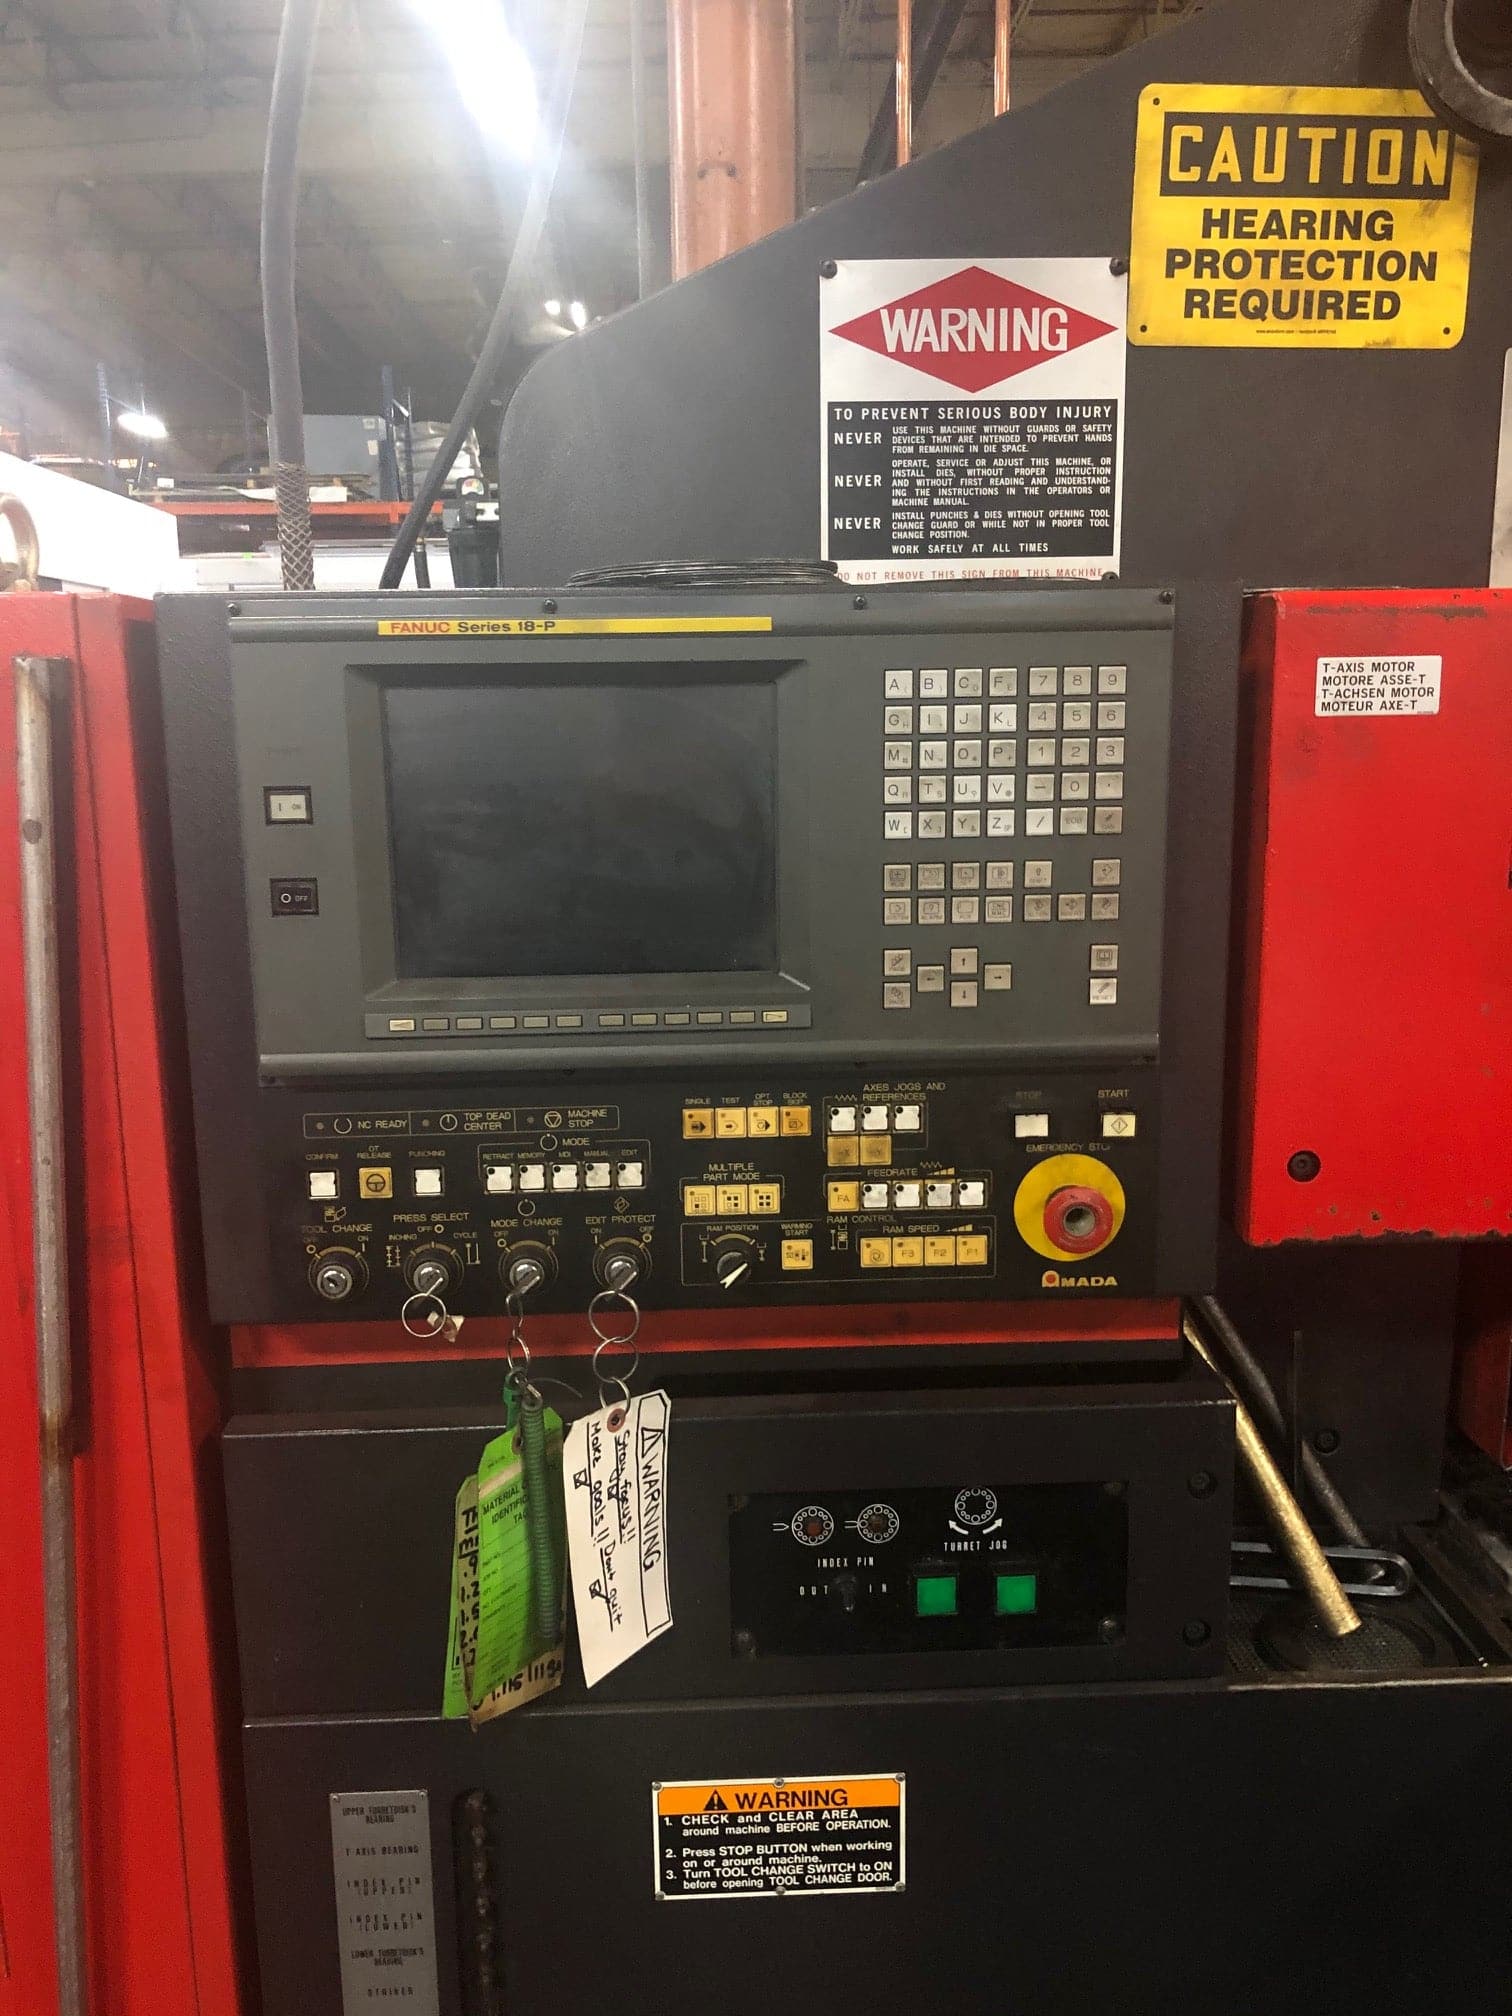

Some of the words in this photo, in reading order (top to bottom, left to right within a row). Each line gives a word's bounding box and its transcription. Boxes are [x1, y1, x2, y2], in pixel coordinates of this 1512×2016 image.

[1169, 125, 1450, 186] CAUTION
[1202, 208, 1394, 241] HEARING
[1165, 248, 1438, 281] PROTECTION
[1184, 288, 1400, 322] REQUIRED
[880, 308, 1068, 352] WARNING
[834, 408, 852, 420] TO
[861, 408, 929, 420] PREVENT
[938, 407, 1001, 419] SERIOUS
[1010, 406, 1047, 418] BODY
[1056, 406, 1111, 418] INJURY
[892, 426, 908, 434] USE
[915, 426, 933, 434] THIS
[940, 426, 976, 434] MACHINE
[983, 425, 1020, 433] WITHOUT
[1027, 425, 1059, 433] GUARDS
[1065, 425, 1076, 433] OR
[1082, 424, 1112, 432] SAFETY
[834, 433, 882, 444] NEVER
[892, 436, 925, 444] DEVICES
[931, 436, 952, 444] THAT
[980, 435, 1020, 443] INTENDED
[1026, 435, 1037, 443] TO
[1042, 434, 1079, 442] PREVENT
[1085, 434, 1112, 442] HANDS
[892, 446, 914, 454] FROM
[919, 445, 964, 453] REMAINING
[970, 445, 978, 453] IN
[984, 445, 997, 453] DIE
[1002, 444, 1029, 452] SPACE.
[892, 460, 930, 468] OPERATE,
[936, 459, 969, 467] SERVICE
[976, 459, 986, 467] OR
[993, 458, 1024, 466] ADJUST
[1031, 458, 1049, 466] THIS
[1056, 458, 1094, 466] MACHINE,
[1101, 457, 1111, 465] OR
[892, 469, 925, 477] INSTALL
[936, 469, 956, 477] DIES,
[967, 468, 1003, 476] WITHOUT
[1015, 468, 1045, 476] PROPER
[1056, 467, 1111, 475] INSTRUCTION
[834, 475, 882, 487] NEVER
[892, 479, 909, 487] AND
[916, 479, 952, 487] WITHOUT
[960, 478, 982, 486] FIRST
[990, 478, 1024, 486] READING
[1031, 477, 1048, 485] AND
[1055, 477, 1110, 485] UNDERSTAND-
[834, 517, 881, 529] NEVER
[892, 545, 919, 554] WORK
[928, 544, 963, 553] SAFELY
[972, 544, 984, 552] AT
[993, 544, 1010, 552] ALL
[1019, 543, 1048, 552] TIMES
[390, 622, 450, 633] FANUC
[458, 621, 511, 632] Series
[518, 621, 555, 632] 18-P
[1323, 662, 1364, 673] T-AXIS
[1371, 662, 1415, 672] MOTOR
[1039, 675, 1047, 685] 7
[1072, 675, 1082, 685] 8
[1108, 674, 1117, 684] 9
[1322, 676, 1374, 686] MOTORE
[1380, 675, 1426, 685] ASSE-T
[1322, 688, 1385, 698] T-ACHSEN
[1391, 687, 1434, 697] MOTOR
[1321, 701, 1373, 711] MOTEUR
[1379, 700, 1417, 710] AXE-T
[863, 1093, 926, 1101] REFERENCES
[1098, 1090, 1129, 1098] START
[464, 1113, 482, 1121] TOP
[486, 1112, 511, 1120] DEAD
[568, 1109, 607, 1118] MACHINE
[375, 1120, 407, 1128] READY
[464, 1122, 502, 1131] CENTER
[568, 1119, 593, 1128] STOP
[563, 1138, 590, 1146] MODE
[709, 1163, 754, 1171] MULTIPLE
[867, 1168, 918, 1176] FEEDRATE
[703, 1173, 727, 1181] PART
[733, 1172, 760, 1180] MODE
[393, 1214, 426, 1222] PRESS
[431, 1213, 470, 1221] SELECT
[491, 1220, 518, 1228] MODE
[523, 1218, 563, 1226] CHANGE
[586, 1216, 606, 1224] EDIT
[612, 1215, 656, 1223] PROTECT
[852, 1215, 896, 1223] CONTROL
[332, 1224, 373, 1232] CHANGE
[590, 1422, 602, 1468] Make
[483, 1488, 518, 1516] MATERIAL
[641, 1457, 663, 1572] WARNING
[944, 1542, 980, 1551] TURRET
[989, 1540, 1008, 1550] JOG
[817, 1558, 848, 1568] INDEX
[857, 1557, 874, 1566] PIN
[800, 1585, 829, 1595] OUT
[870, 1584, 887, 1593] IN
[607, 1588, 622, 1626] quit
[734, 1788, 848, 1809] WARNING
[664, 1817, 673, 1827] 1.
[681, 1814, 729, 1825] CHECK
[738, 1813, 761, 1823] and
[769, 1811, 814, 1822] CLEAR
[822, 1809, 858, 1820] AREA
[682, 1826, 719, 1836] around
[725, 1824, 770, 1834] machine
[776, 1822, 820, 1833] BEFORE
[826, 1819, 891, 1831] OPERATION.
[665, 1849, 676, 1858] 2.
[682, 1848, 715, 1858] Press
[719, 1846, 753, 1856] STOP
[756, 1844, 808, 1855] BUTTON
[811, 1842, 842, 1852] when
[846, 1841, 892, 1853] working
[683, 1860, 698, 1868] on
[703, 1859, 715, 1867] or
[721, 1856, 762, 1866] around
[768, 1854, 822, 1864] machine.
[666, 1870, 677, 1880] 3.
[683, 1869, 710, 1879] Turn
[714, 1867, 748, 1878] TOOL
[751, 1865, 804, 1876] CHANGE
[807, 1863, 856, 1874] SWITCH
[859, 1863, 870, 1871] to
[874, 1861, 892, 1871] ON
[683, 1879, 717, 1889] before
[722, 1878, 763, 1890] opening
[769, 1876, 799, 1886] TOOL
[804, 1874, 851, 1884] CHANGE
[857, 1872, 892, 1882] DOOR.
